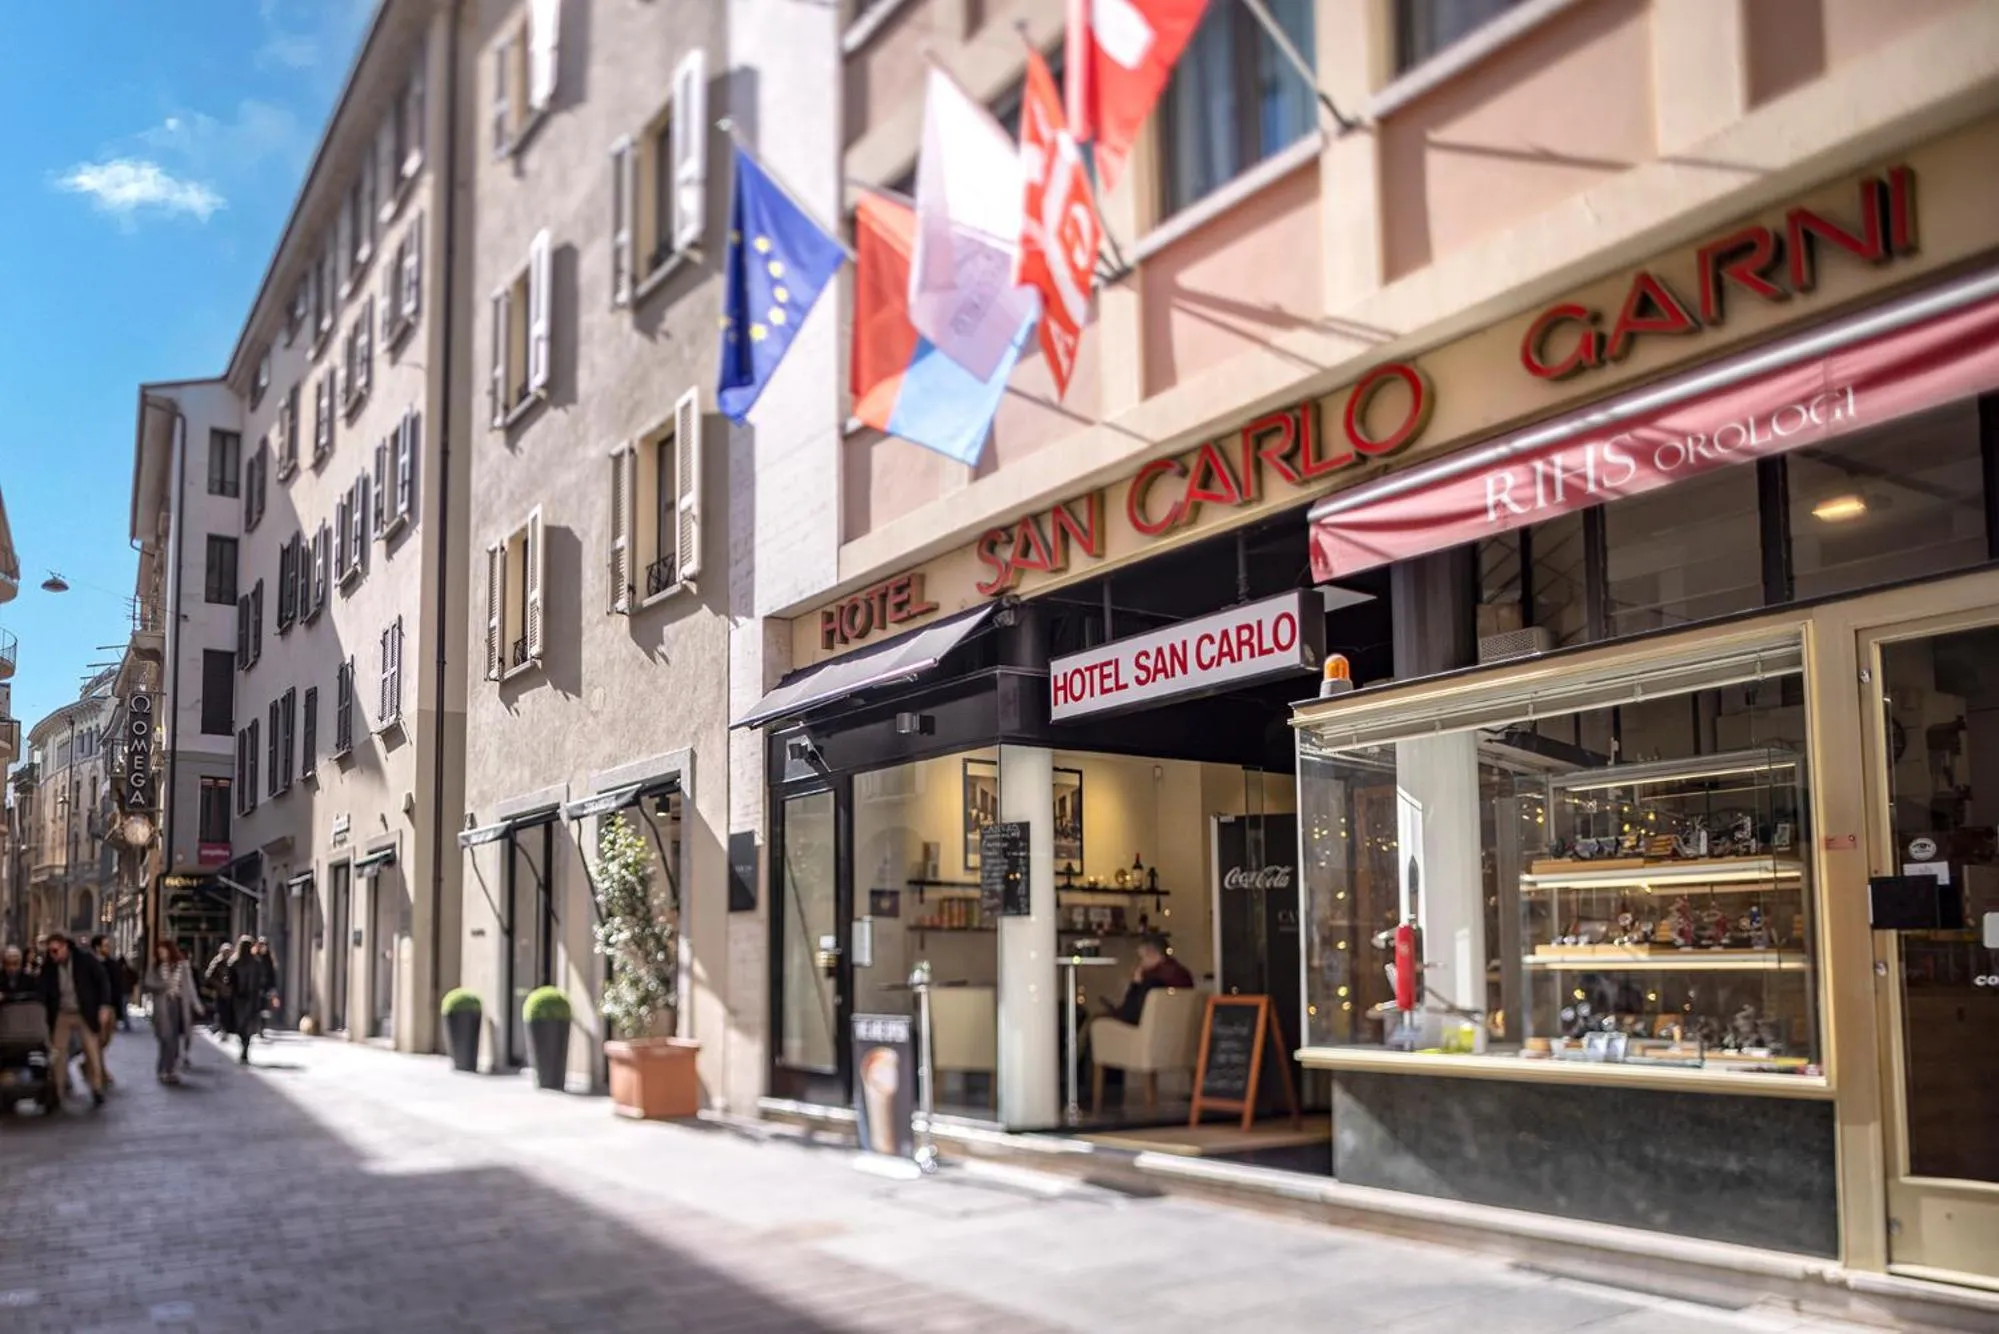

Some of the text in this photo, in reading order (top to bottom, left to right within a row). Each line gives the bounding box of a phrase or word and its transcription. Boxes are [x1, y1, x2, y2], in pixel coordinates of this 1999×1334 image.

[821, 163, 1919, 650] HOTEL SAN CARLO GARNI
[1484, 384, 1857, 523] RIHS OROLOGI
[1053, 611, 1297, 707] HOTEL SAN CARLO
[129, 720, 148, 805] OMEGA
